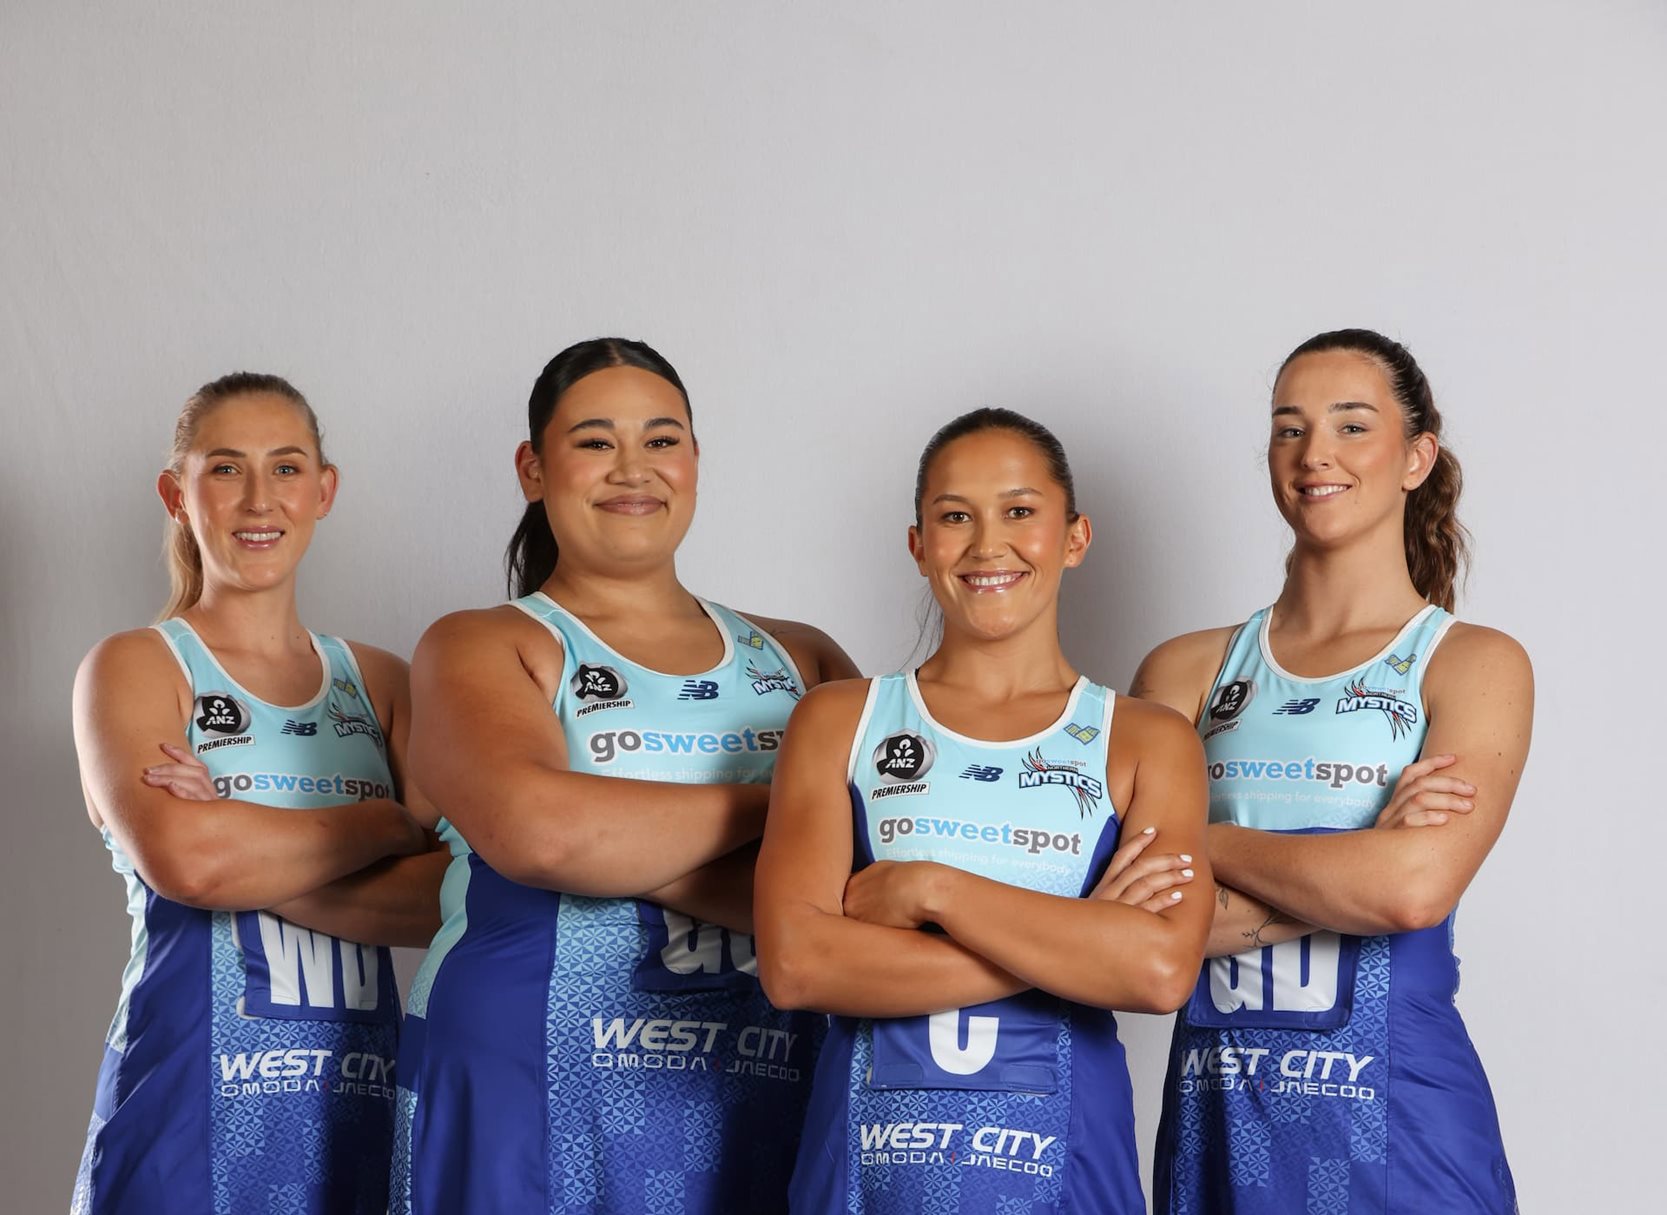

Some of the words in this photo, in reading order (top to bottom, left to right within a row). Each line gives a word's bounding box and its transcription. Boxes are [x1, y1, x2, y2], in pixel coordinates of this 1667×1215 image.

[585, 682, 612, 693] ANZ
[206, 715, 235, 725] ANZ
[576, 700, 631, 717] PREMIERSHIP
[1216, 701, 1238, 713] ANZ
[1336, 696, 1417, 724] MYSTICS
[197, 737, 252, 754] PREMIERSHIP
[590, 727, 784, 762] gosweets
[885, 759, 915, 768] ANZ
[1207, 758, 1388, 788] osweetspot
[872, 784, 927, 799] PREMIERSHIP
[1019, 770, 1102, 799] MYSTICS
[879, 816, 1081, 855] gosweetspot
[593, 1018, 727, 1052] WEST
[737, 1026, 798, 1062] CITY
[220, 1050, 332, 1080] WEST
[341, 1052, 395, 1083] CITY
[1181, 1047, 1269, 1076] WEST
[1280, 1051, 1374, 1082] CITY
[860, 1123, 963, 1150] WEST
[972, 1127, 1057, 1159] CITY
